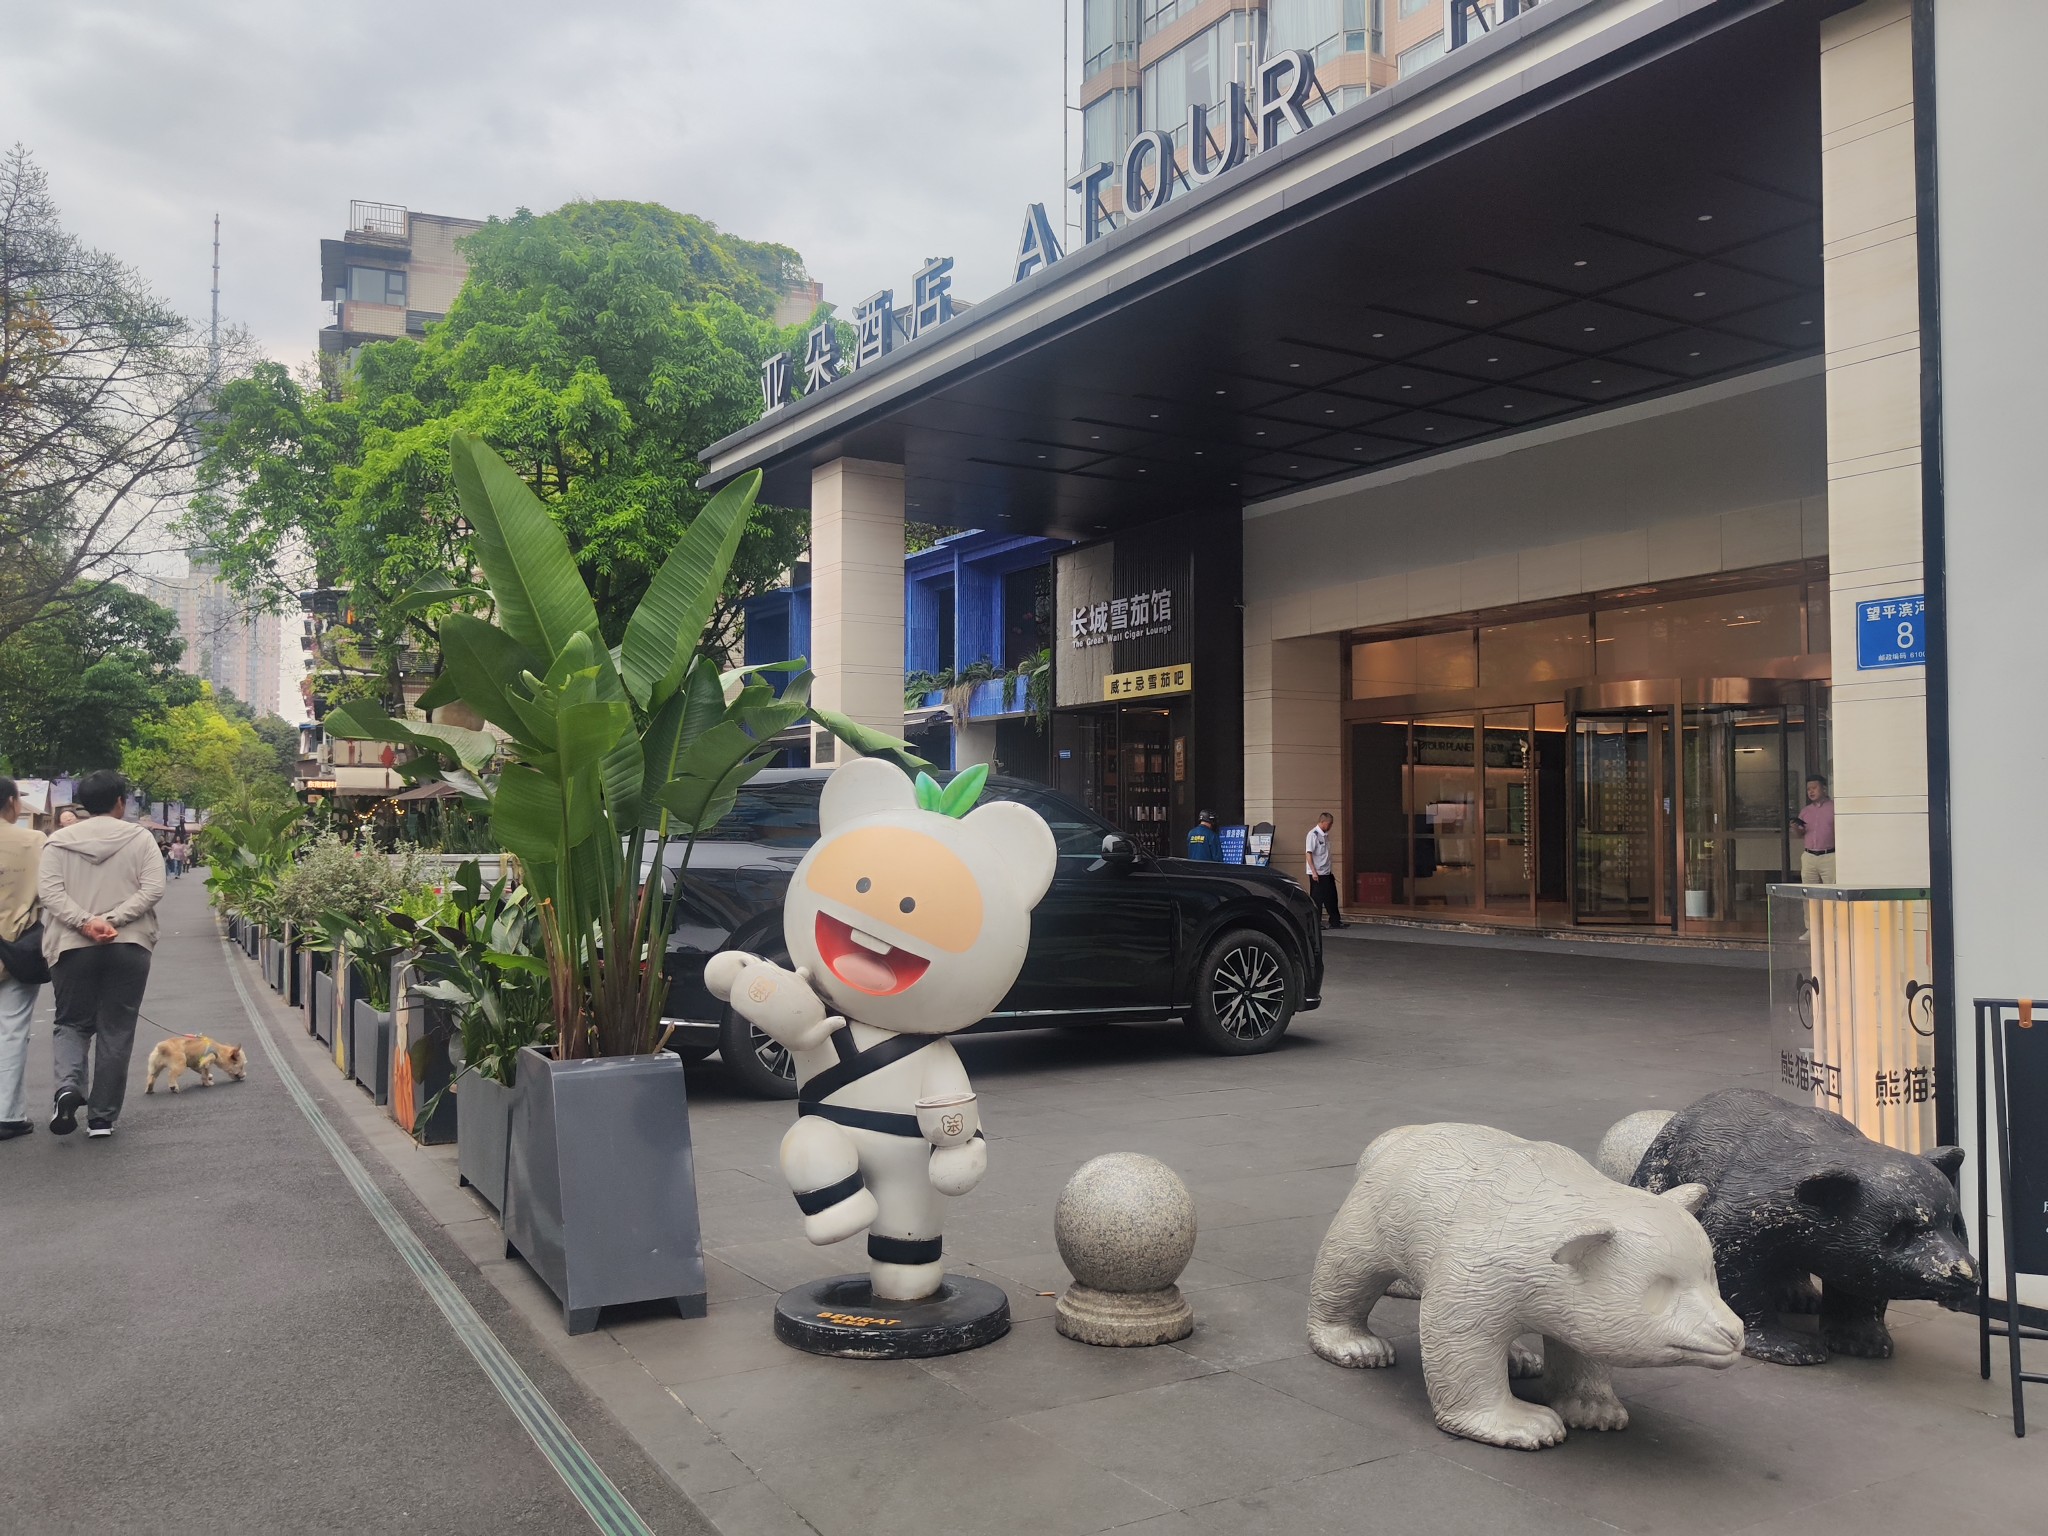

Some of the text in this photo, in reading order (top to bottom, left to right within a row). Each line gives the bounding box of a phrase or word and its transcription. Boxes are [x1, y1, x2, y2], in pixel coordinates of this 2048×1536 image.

[1013, 49, 1316, 284] ATOUR
[761, 257, 951, 418] 亚朵酒店
[1071, 588, 1172, 638] 长城雪茄馆
[1072, 625, 1171, 648] The Great Wall Cigar Lounge
[1897, 621, 1914, 649] 8
[1878, 652, 1907, 661] 邮政编码
[1110, 670, 1184, 694] 威士忌雪茄吧
[1781, 1050, 1842, 1103] 熊猫采耳
[1876, 1066, 1936, 1106] 熊猫
